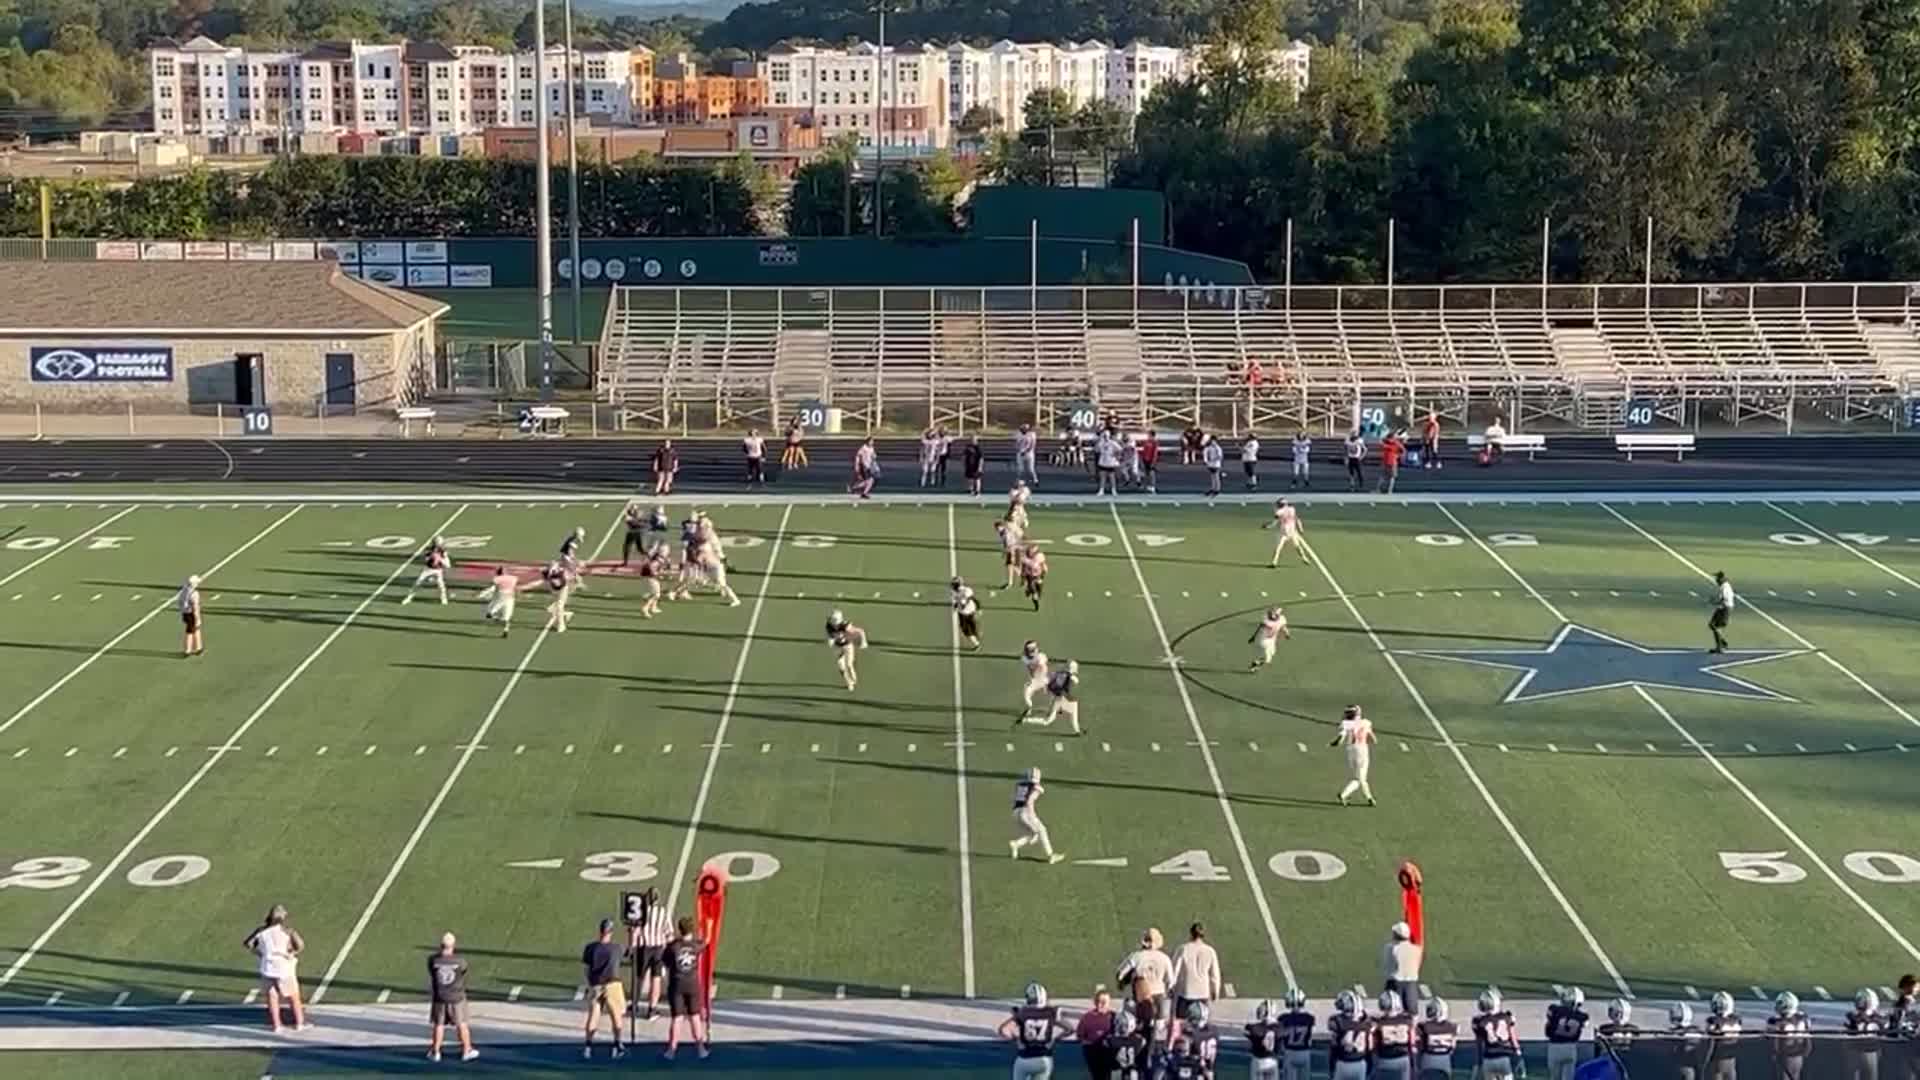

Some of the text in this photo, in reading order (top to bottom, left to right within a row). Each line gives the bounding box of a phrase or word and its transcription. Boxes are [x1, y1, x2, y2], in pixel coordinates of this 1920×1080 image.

[97, 366, 167, 376] FOOTBALL
[245, 412, 269, 430] 10
[800, 409, 823, 426] 30
[1071, 410, 1095, 428] 40
[1362, 408, 1385, 425] 50
[1629, 407, 1652, 424] 40
[0, 855, 211, 889] 20
[579, 851, 781, 882] 30
[1149, 850, 1347, 881] 40
[1718, 851, 1920, 883] 50
[626, 895, 643, 921] 3
[1023, 1018, 1049, 1041] 67
